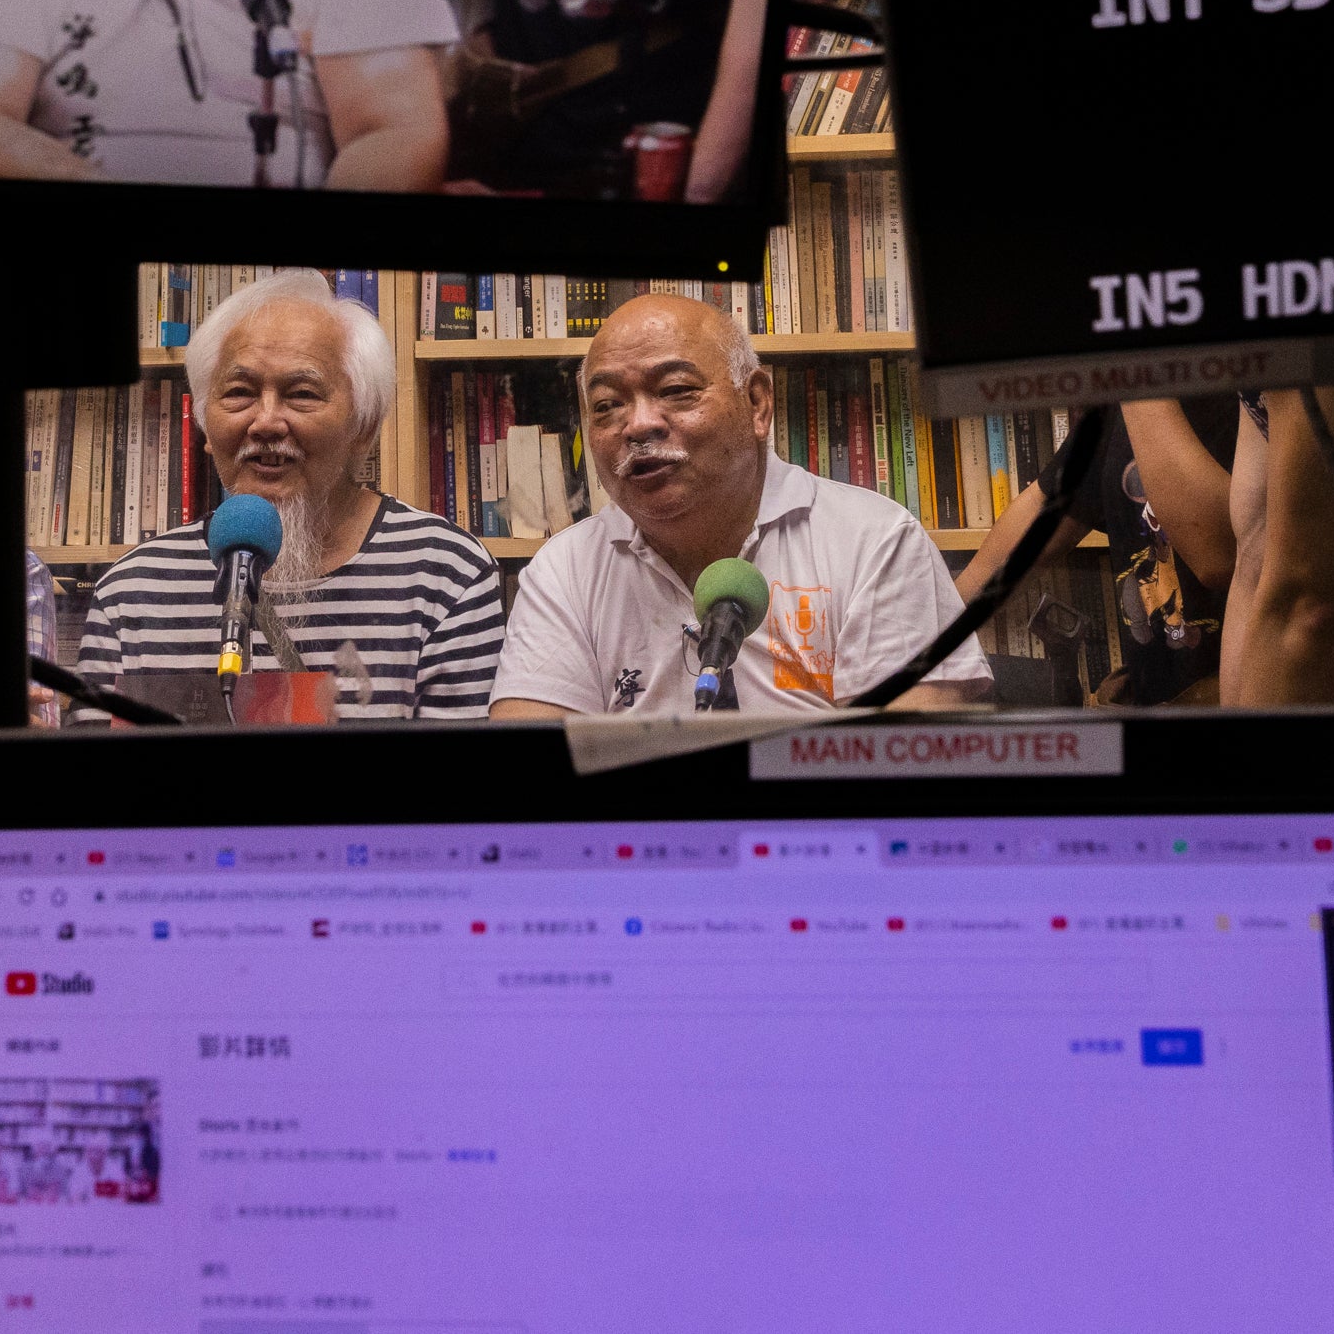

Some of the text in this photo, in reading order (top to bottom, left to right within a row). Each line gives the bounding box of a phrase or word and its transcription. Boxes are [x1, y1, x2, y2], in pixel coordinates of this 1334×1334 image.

[1090, 270, 1203, 332] IN5
[978, 372, 1081, 402] VIDEO
[1197, 352, 1271, 380] OUT
[905, 429, 913, 448] New
[906, 449, 915, 467] Left
[790, 733, 1079, 765] MAIN COMPUTER
[41, 972, 95, 995] Studio
